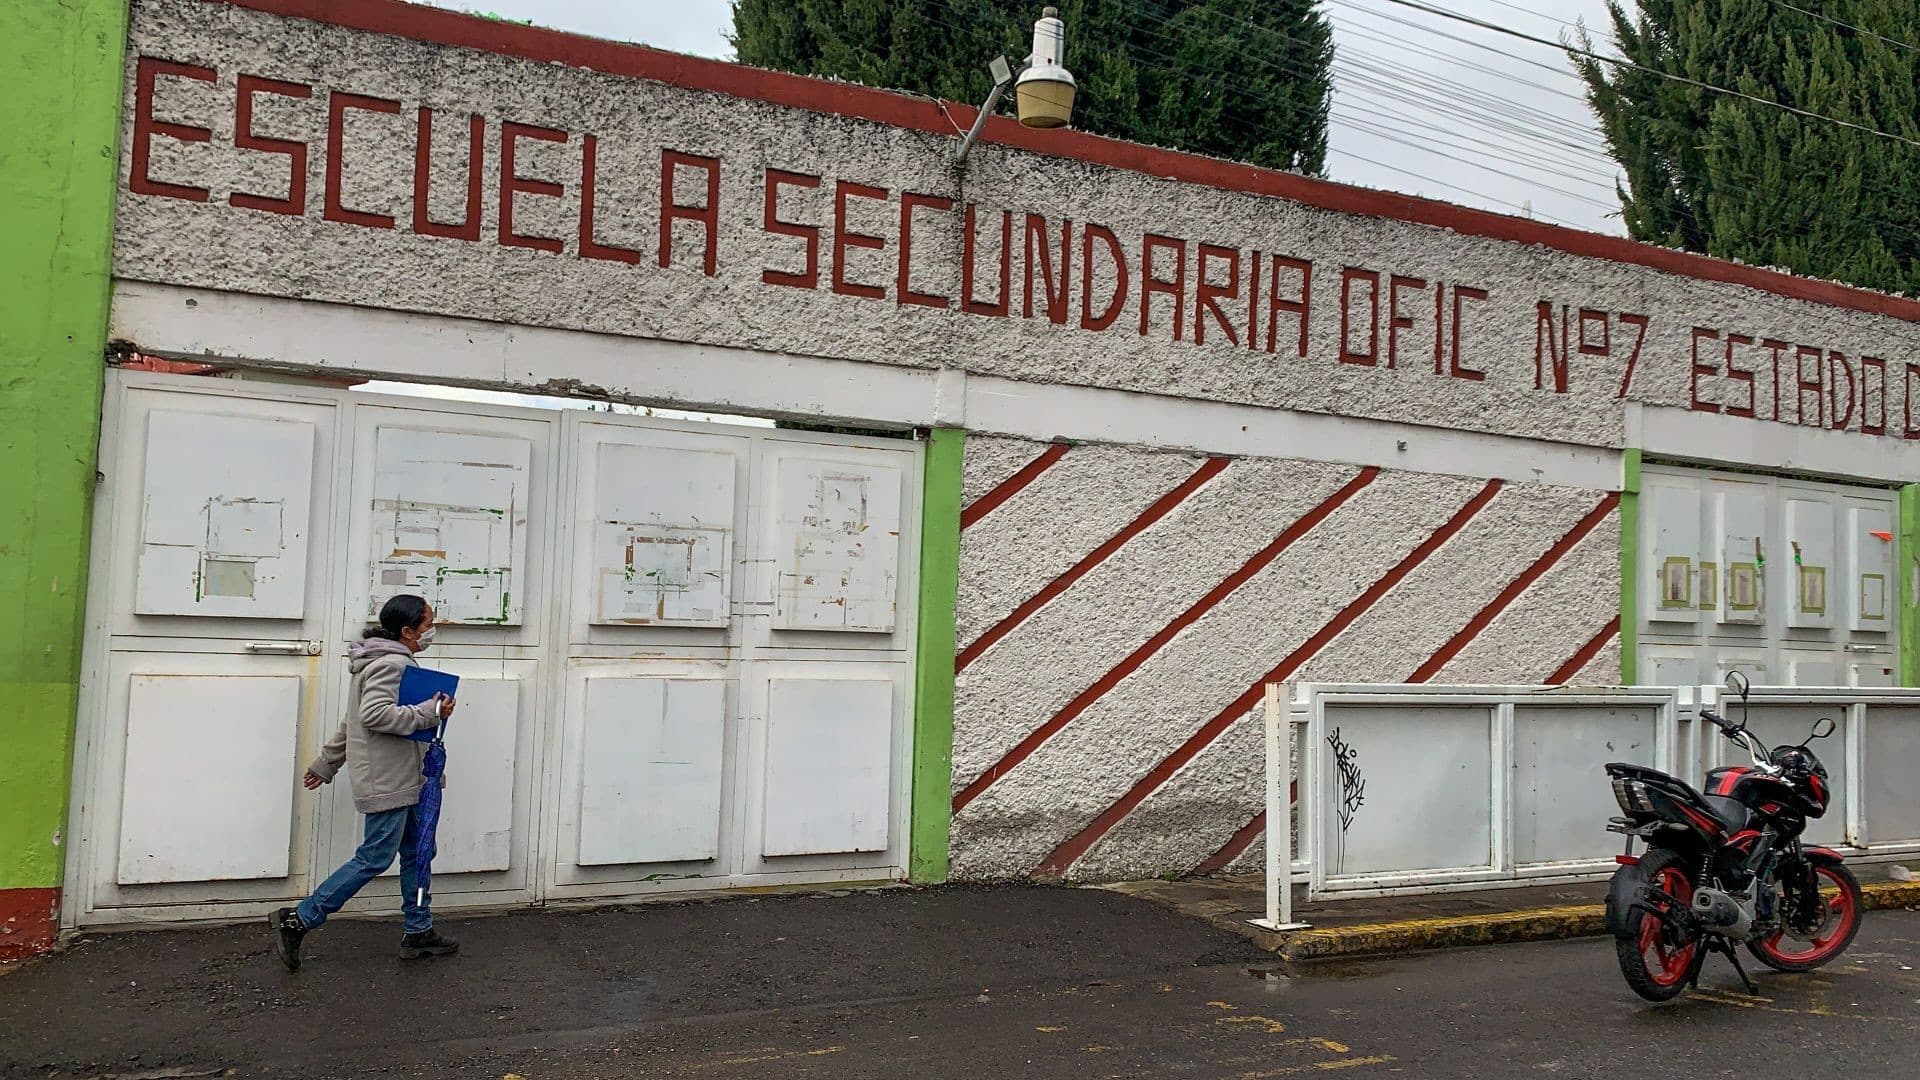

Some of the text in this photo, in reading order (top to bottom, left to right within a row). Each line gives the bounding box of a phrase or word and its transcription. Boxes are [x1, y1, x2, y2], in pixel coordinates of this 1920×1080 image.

[130, 56, 720, 276] ESCUELA
[762, 167, 1312, 357] SECUNDARIA
[1340, 266, 1488, 381] OFIC
[1692, 326, 1886, 436] ESTADO
